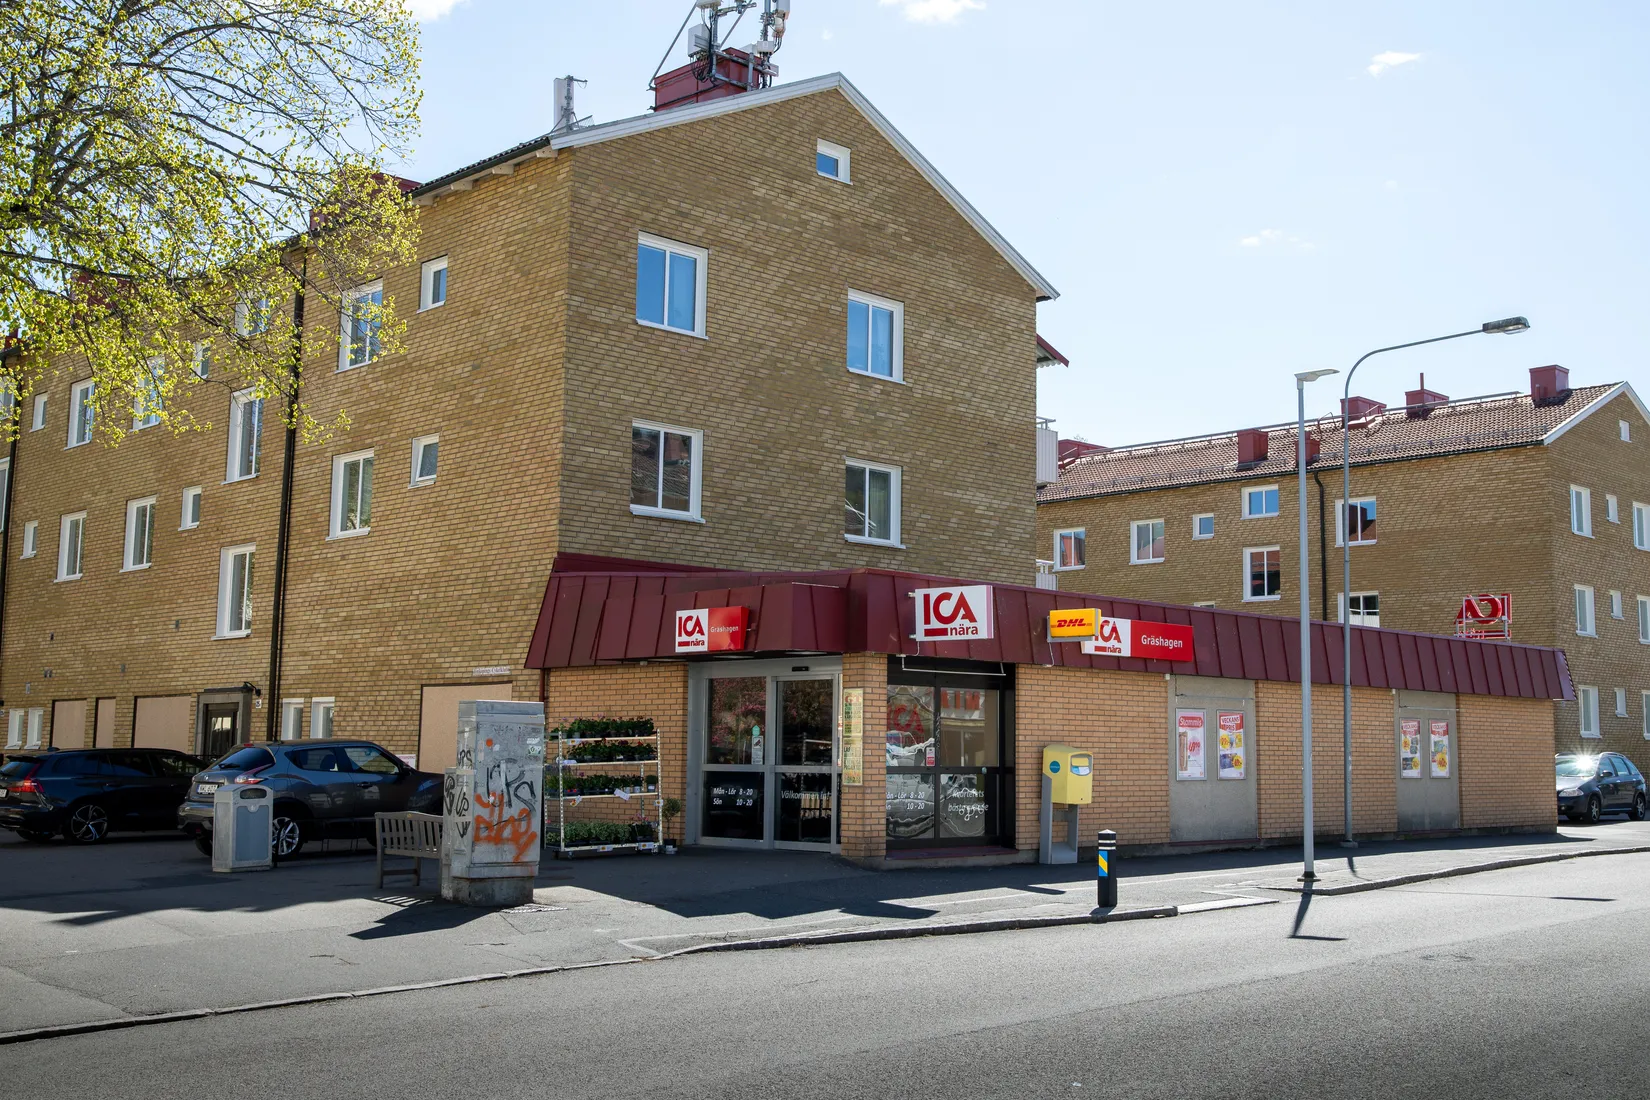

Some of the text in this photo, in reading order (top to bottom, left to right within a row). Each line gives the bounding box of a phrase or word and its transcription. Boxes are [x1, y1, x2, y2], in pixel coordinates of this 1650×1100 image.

[923, 591, 978, 625] ICA
[677, 615, 705, 637] ICA
[1056, 618, 1086, 628] DHL
[710, 625, 739, 634] Gräshagen
[950, 624, 979, 636] nära
[1095, 619, 1122, 643] CA
[690, 638, 705, 647] nära
[1141, 634, 1183, 649] Gräshagen
[1107, 644, 1122, 654] nära
[1180, 717, 1202, 726] Stammis
[713, 787, 725, 795] Mån
[728, 787, 736, 795] Lör
[781, 790, 819, 800] Välkommen
[898, 791, 907, 799] Lör
